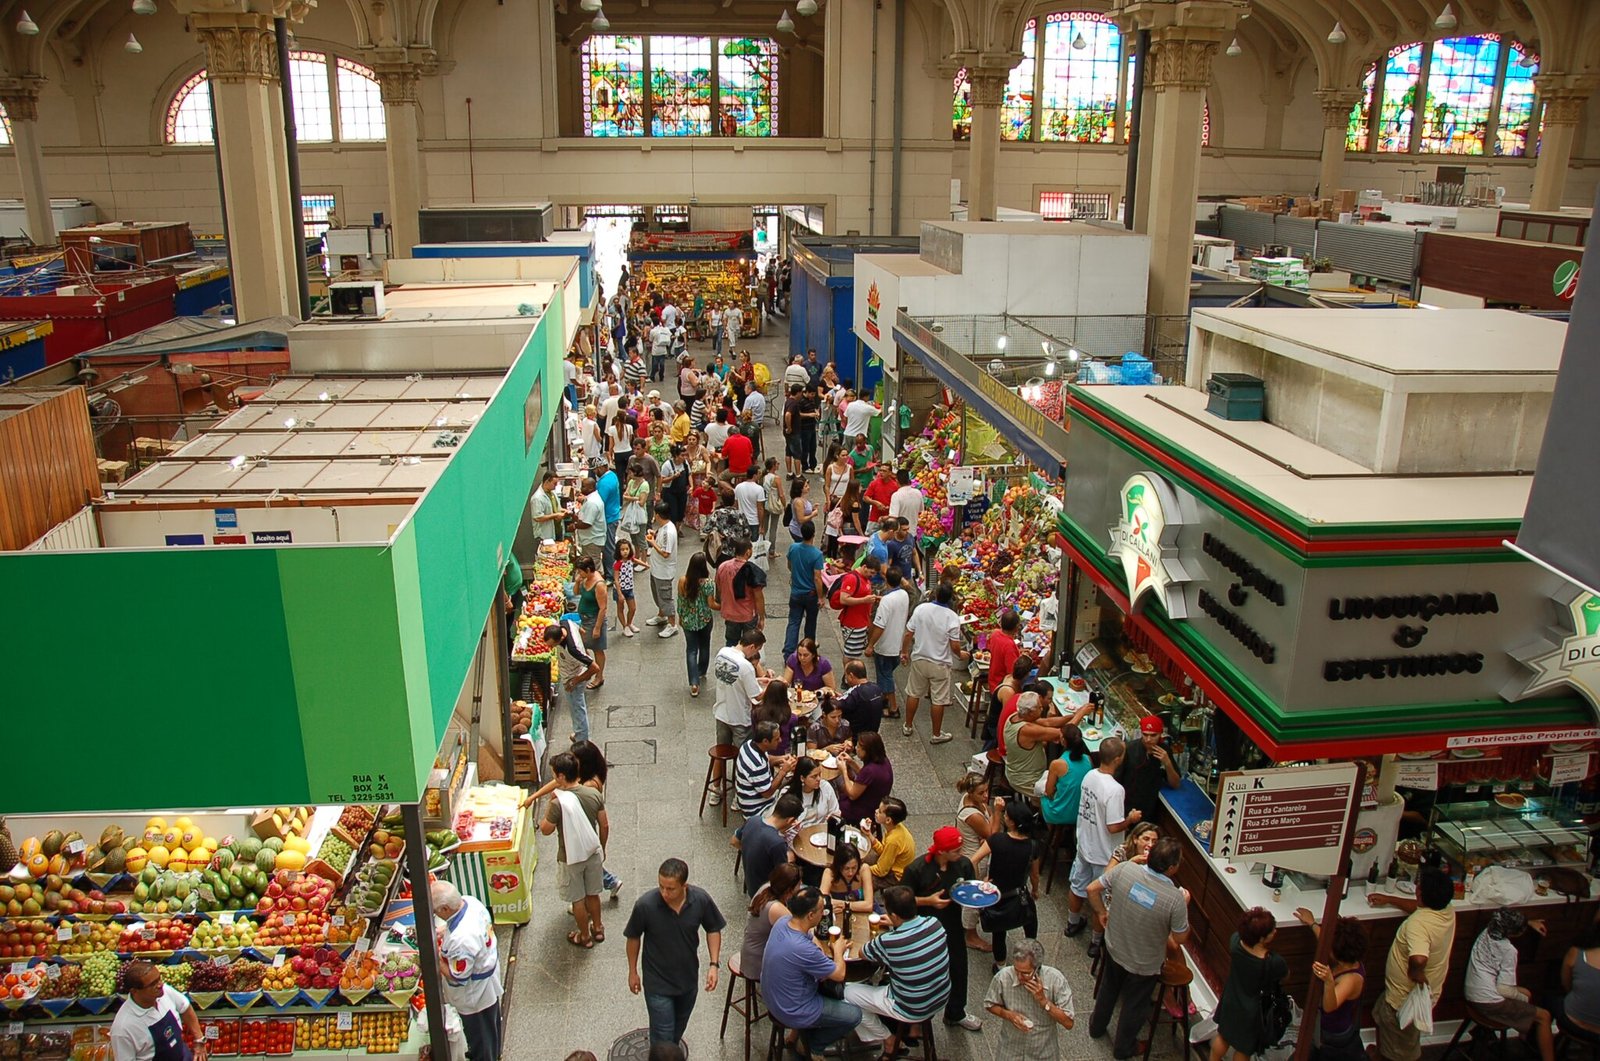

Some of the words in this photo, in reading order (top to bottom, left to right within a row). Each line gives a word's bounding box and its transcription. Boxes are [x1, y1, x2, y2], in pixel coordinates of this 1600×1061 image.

[276, 534, 290, 542] aqui
[1122, 531, 1128, 541] DI
[1129, 535, 1158, 567] CALLANI
[1328, 592, 1499, 622] LINGUIÇARIA
[1393, 624, 1428, 648] &
[1568, 647, 1586, 661] DI
[1323, 653, 1484, 682] ESPETINHOS
[1467, 733, 1533, 744] Fabricação
[1537, 730, 1579, 741] Própria
[1583, 729, 1597, 737] de
[379, 774, 386, 782] K
[354, 784, 372, 792] BOX
[378, 783, 389, 791] 24
[1227, 782, 1247, 791] Rua
[1253, 777, 1265, 789] K
[328, 794, 345, 802] TEL
[352, 792, 394, 801] 3229-5831
[1248, 807, 1262, 815] Rua
[1273, 804, 1307, 813] Cantareira
[1280, 817, 1301, 826] Março
[1244, 832, 1259, 840] Táxi
[1242, 845, 1263, 853] Sucos
